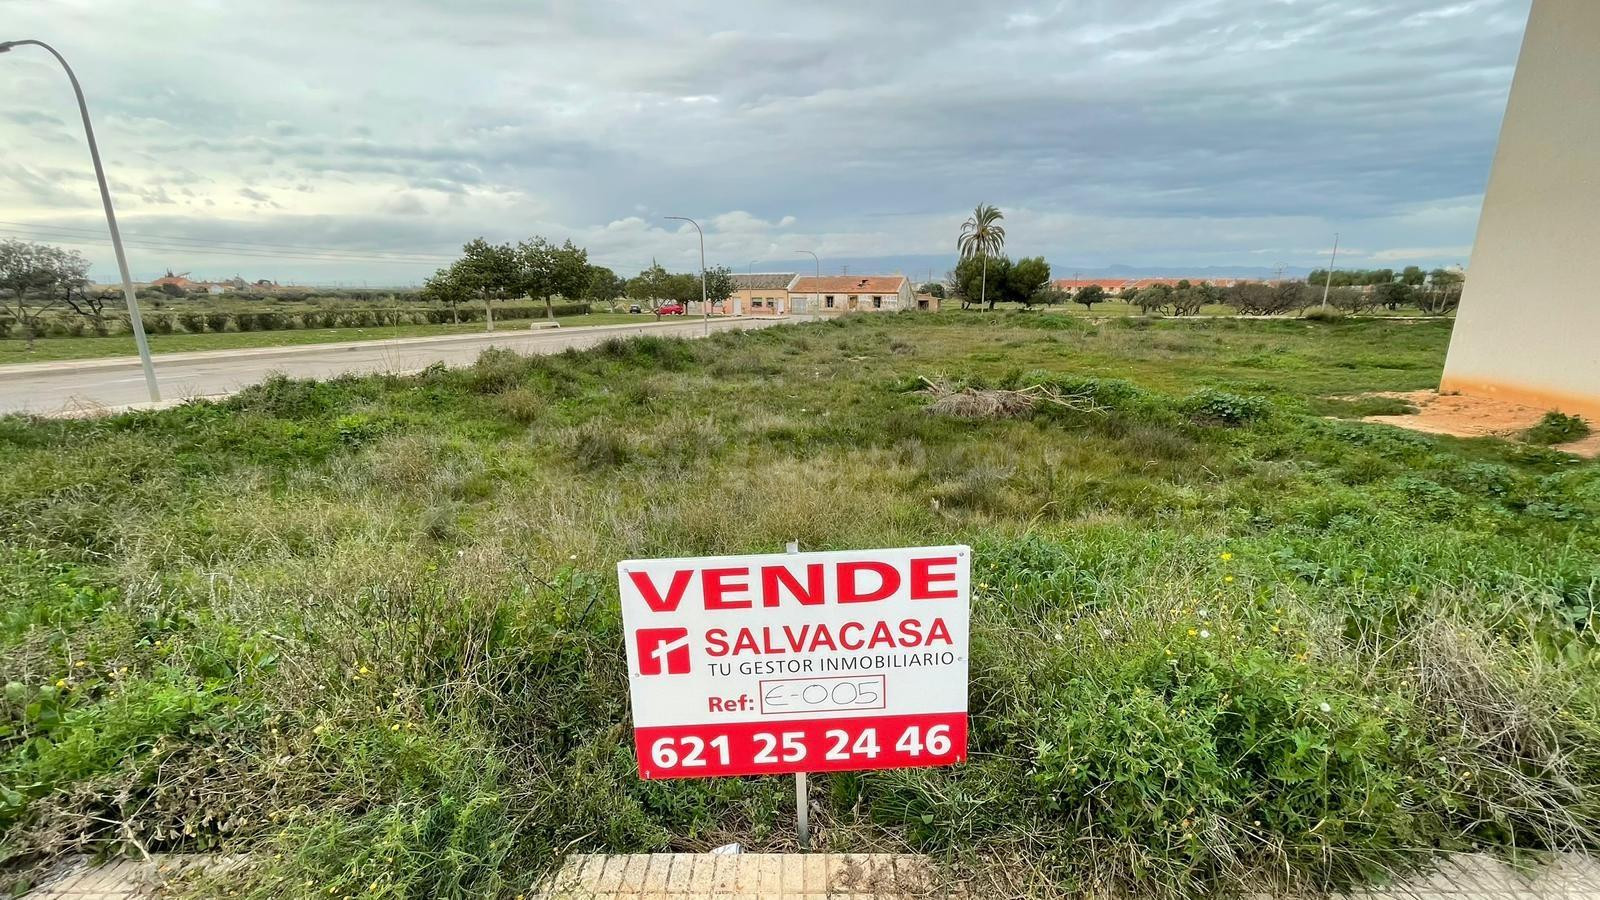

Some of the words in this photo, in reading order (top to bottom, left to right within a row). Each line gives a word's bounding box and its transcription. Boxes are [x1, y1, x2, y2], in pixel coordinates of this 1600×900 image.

[628, 556, 958, 613] VENDE
[704, 617, 954, 657] SALVACASA
[708, 662, 731, 677] TU
[739, 659, 813, 676] GESTOR
[820, 651, 955, 672] INMOBILIARIO
[708, 694, 755, 713] Ref:
[650, 735, 731, 769] 621
[752, 731, 807, 765] 25
[825, 727, 881, 761] 24
[895, 724, 952, 756] 46
